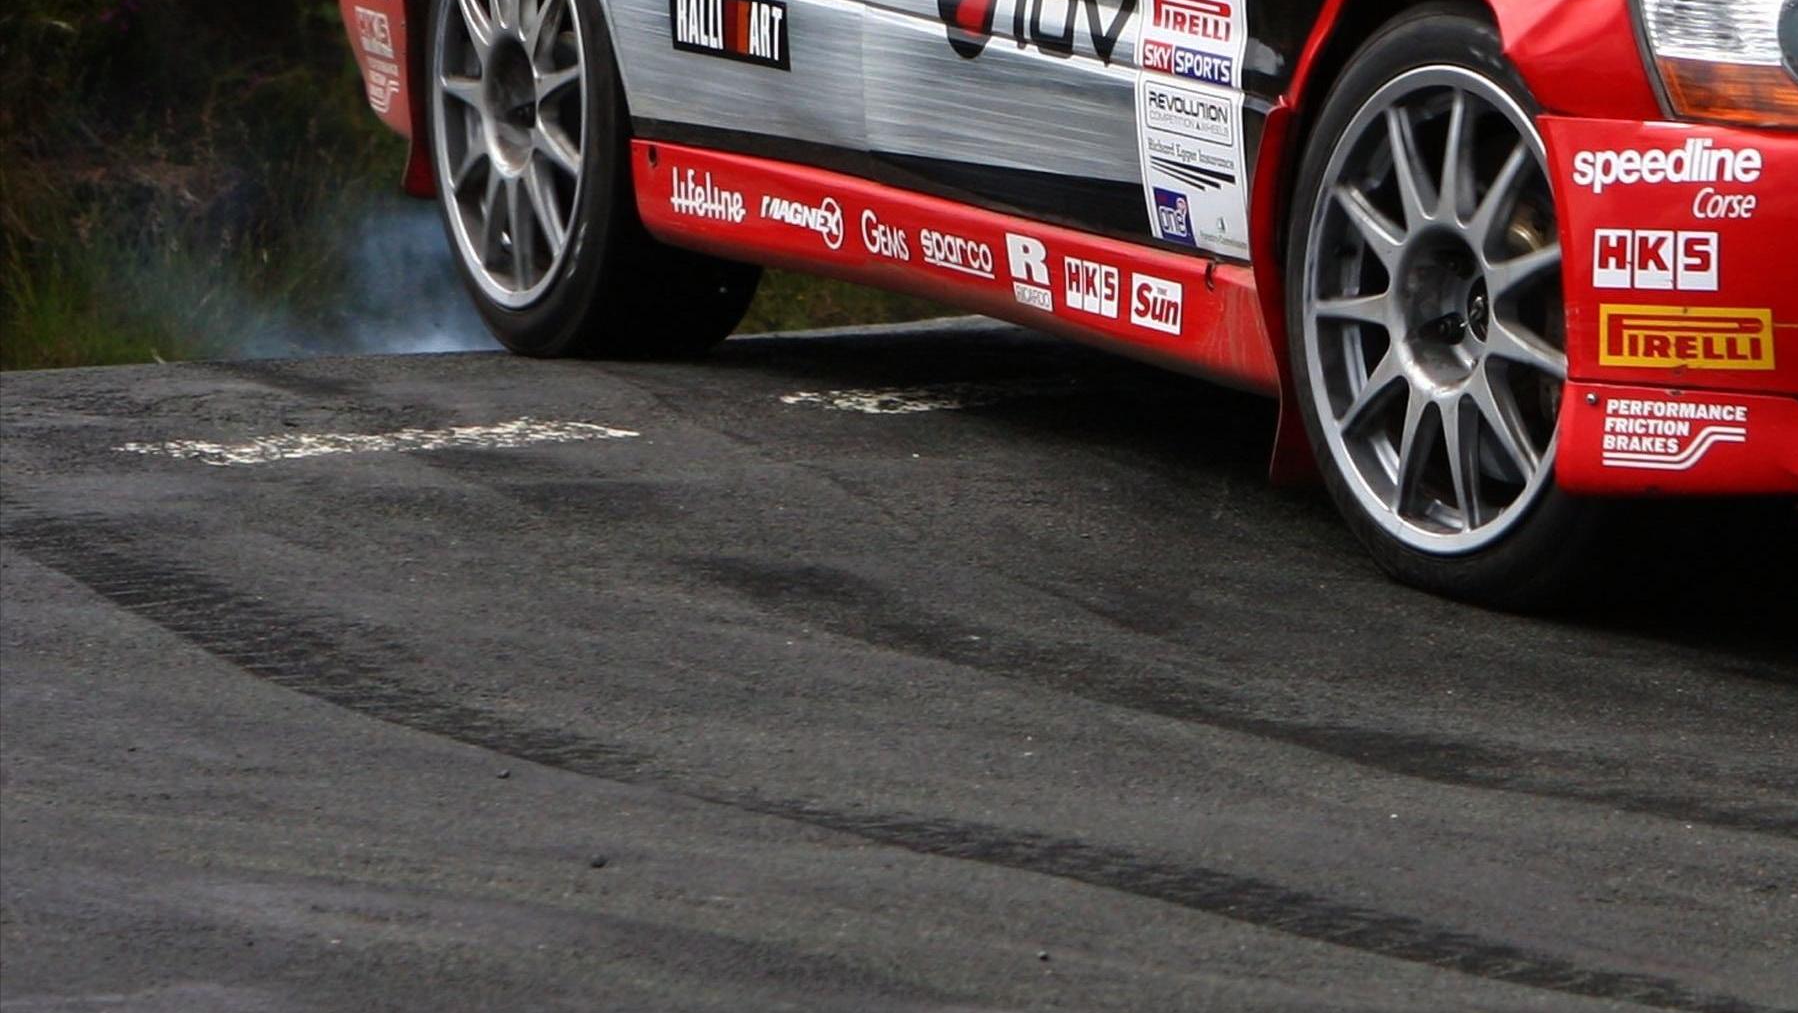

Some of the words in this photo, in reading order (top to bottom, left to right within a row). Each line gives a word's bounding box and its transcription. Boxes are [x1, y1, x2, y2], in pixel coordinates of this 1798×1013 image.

[749, 1, 783, 61] ART
[1144, 43, 1173, 71] SKY
[1174, 48, 1232, 83] SPORTS
[1149, 90, 1228, 125] REVOLUTION
[1573, 137, 1762, 194] speedline
[760, 195, 843, 238] MAGNEX
[1692, 187, 1756, 219] Corse
[919, 228, 993, 275] sparco
[1006, 232, 1051, 286] R
[1598, 234, 1712, 273] HKS
[1014, 284, 1052, 310] RICARDO
[1066, 259, 1117, 302] HKS
[1134, 282, 1179, 327] Sun
[1607, 313, 1764, 361] PIRELLI
[1604, 416, 1690, 437] FRICTION
[1606, 398, 1748, 422] PERFORMANCE
[1603, 434, 1680, 454] BRAKES
